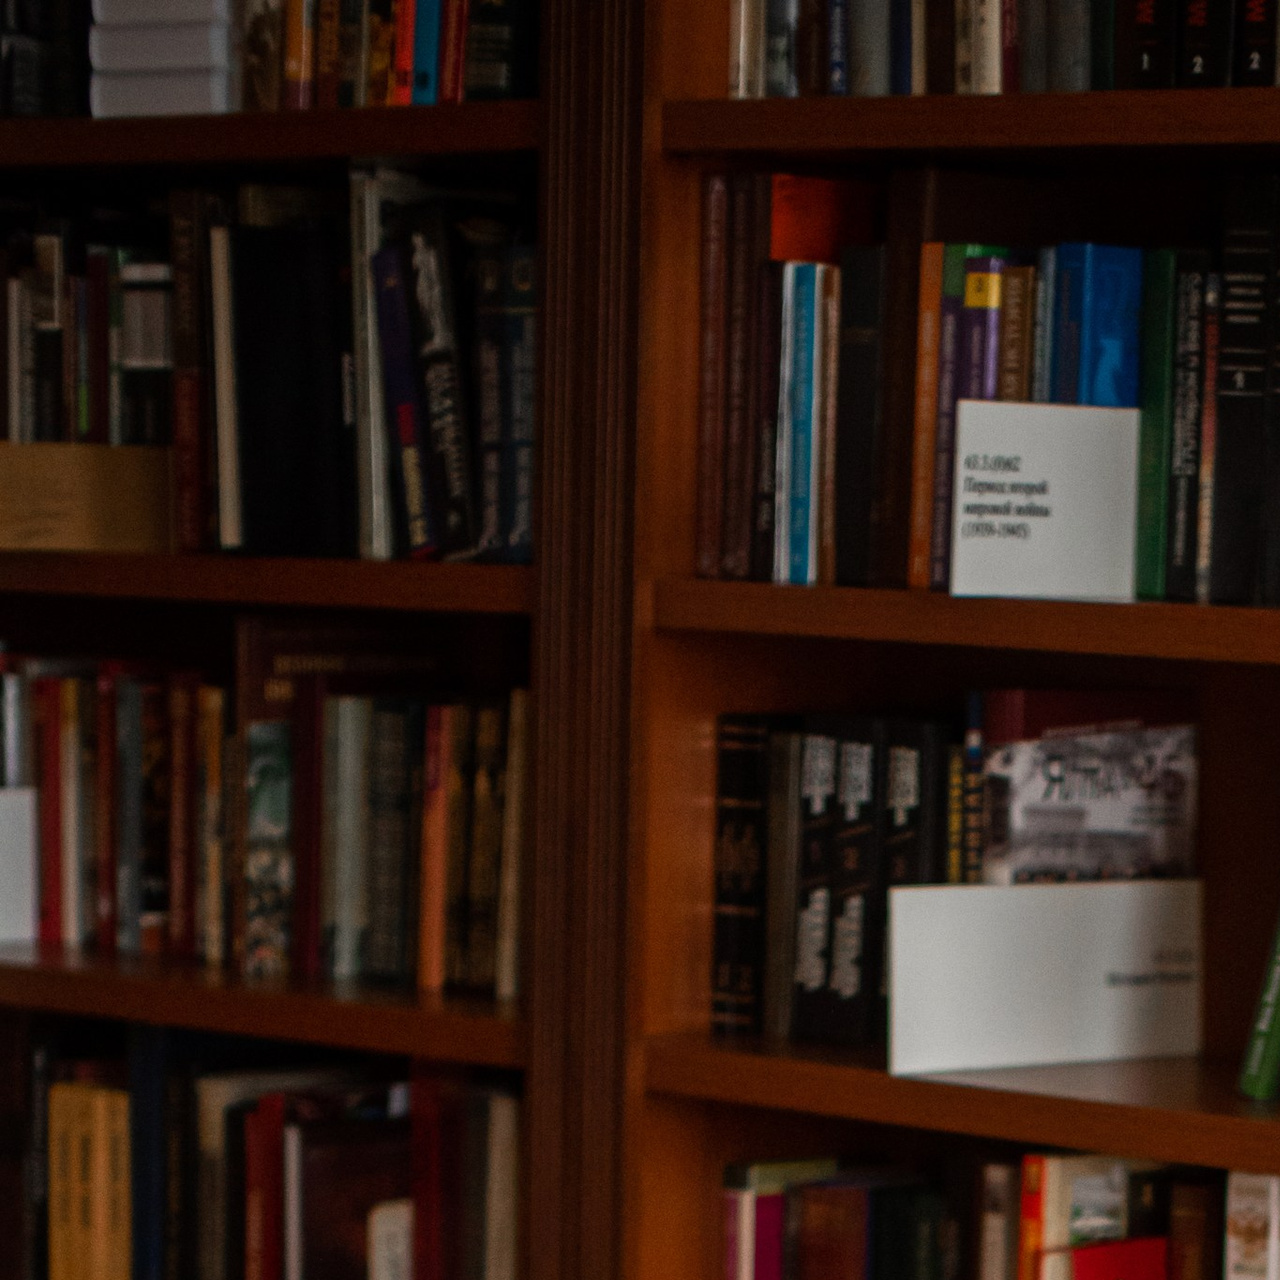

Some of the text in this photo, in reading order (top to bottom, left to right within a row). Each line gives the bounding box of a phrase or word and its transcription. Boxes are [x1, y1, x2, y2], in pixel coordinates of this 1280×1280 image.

[1192, 55, 1205, 74] 2
[1249, 51, 1261, 71] 2
[1233, 371, 1245, 390] 1
